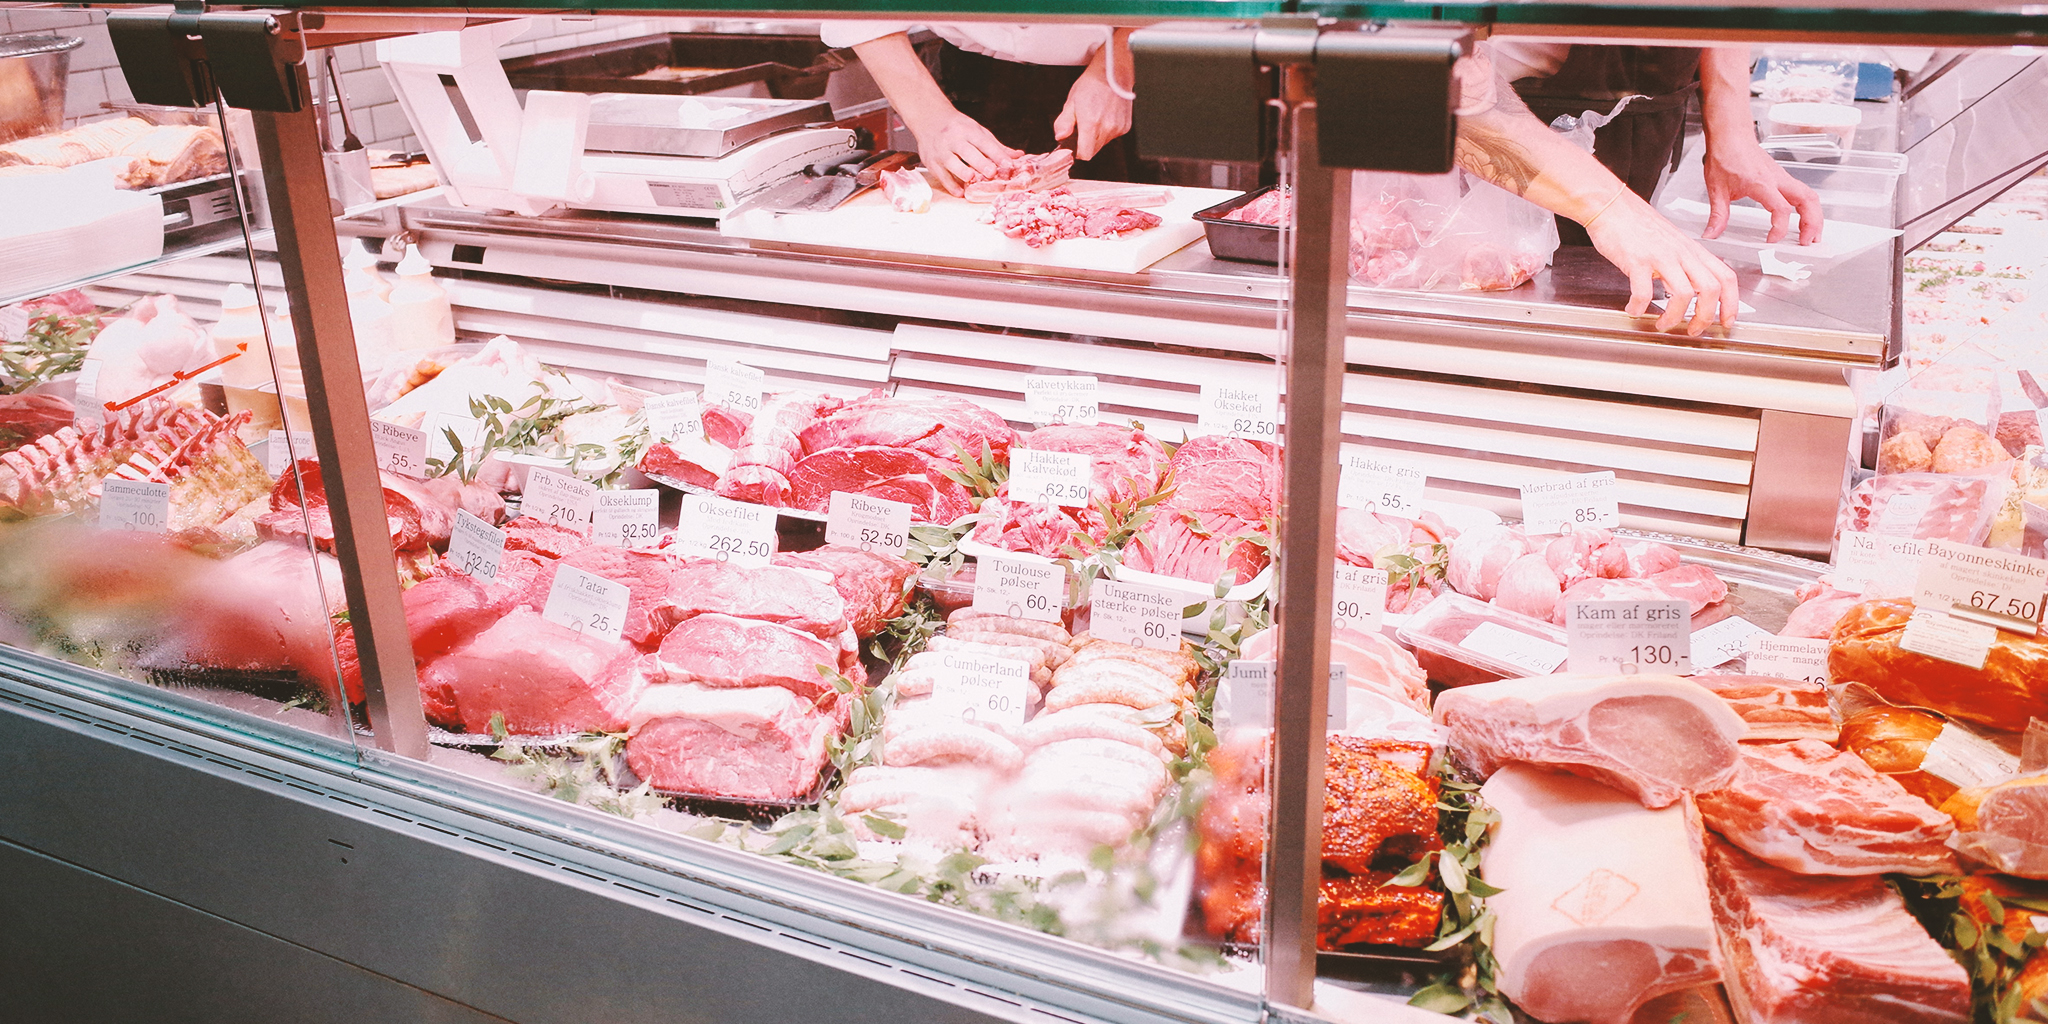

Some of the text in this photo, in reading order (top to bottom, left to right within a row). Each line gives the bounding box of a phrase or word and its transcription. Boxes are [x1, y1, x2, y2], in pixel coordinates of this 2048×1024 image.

[1027, 379, 1096, 391] Kalvetykkam
[728, 390, 758, 409] 52,50
[1219, 388, 1259, 402] Hakket
[1058, 405, 1096, 419] 67,50
[1214, 399, 1262, 413] Oksekød
[382, 424, 418, 442] Ribeye
[1234, 418, 1275, 435] 62,50
[392, 453, 417, 470] 55,-
[1030, 452, 1070, 465] Hakket
[1023, 462, 1076, 476] Kalvekød
[1350, 457, 1392, 473] Hakket
[1396, 467, 1421, 479] gris
[104, 482, 167, 498] Lammeculotte
[534, 472, 553, 486] Frb.
[557, 478, 590, 497] Steaks
[1046, 483, 1088, 499] 62,50
[1522, 476, 1615, 494] Mørbrad af gris
[600, 495, 652, 507] Okseklump
[851, 498, 891, 515] Ribeye
[1381, 493, 1411, 511] 55,-
[133, 512, 164, 528] 100,-
[551, 504, 583, 524] 210,-
[698, 501, 760, 521] Oksefilet
[1575, 507, 1609, 523] 85,-
[457, 512, 504, 548] Tykstegsfilet
[622, 524, 656, 540] 92,50
[860, 528, 903, 548] 52,50
[710, 534, 769, 557] 262,50
[466, 550, 497, 578] 132,50
[993, 560, 1051, 579] Toulouse
[1927, 543, 2046, 578] Bayonneskinke
[1950, 564, 1980, 575] magert
[579, 575, 608, 596] Tatar
[1000, 576, 1040, 590] pølser
[1345, 570, 1387, 585] af gris
[1027, 594, 1058, 613] 60,-
[1105, 584, 1173, 606] Ungarnske
[1938, 593, 1950, 601] 1/2
[1094, 598, 1181, 620] stærke pølser
[1337, 600, 1371, 621] 90,-
[1576, 604, 1681, 621] Kam af gris
[590, 613, 618, 635] 25,-
[1144, 622, 1177, 642] 60,-
[1630, 645, 1688, 666] 130,-
[1747, 651, 1778, 662] Pølser
[944, 654, 1023, 678] Cumberland
[961, 674, 1002, 689] pølser
[988, 694, 1021, 714] 60,-
